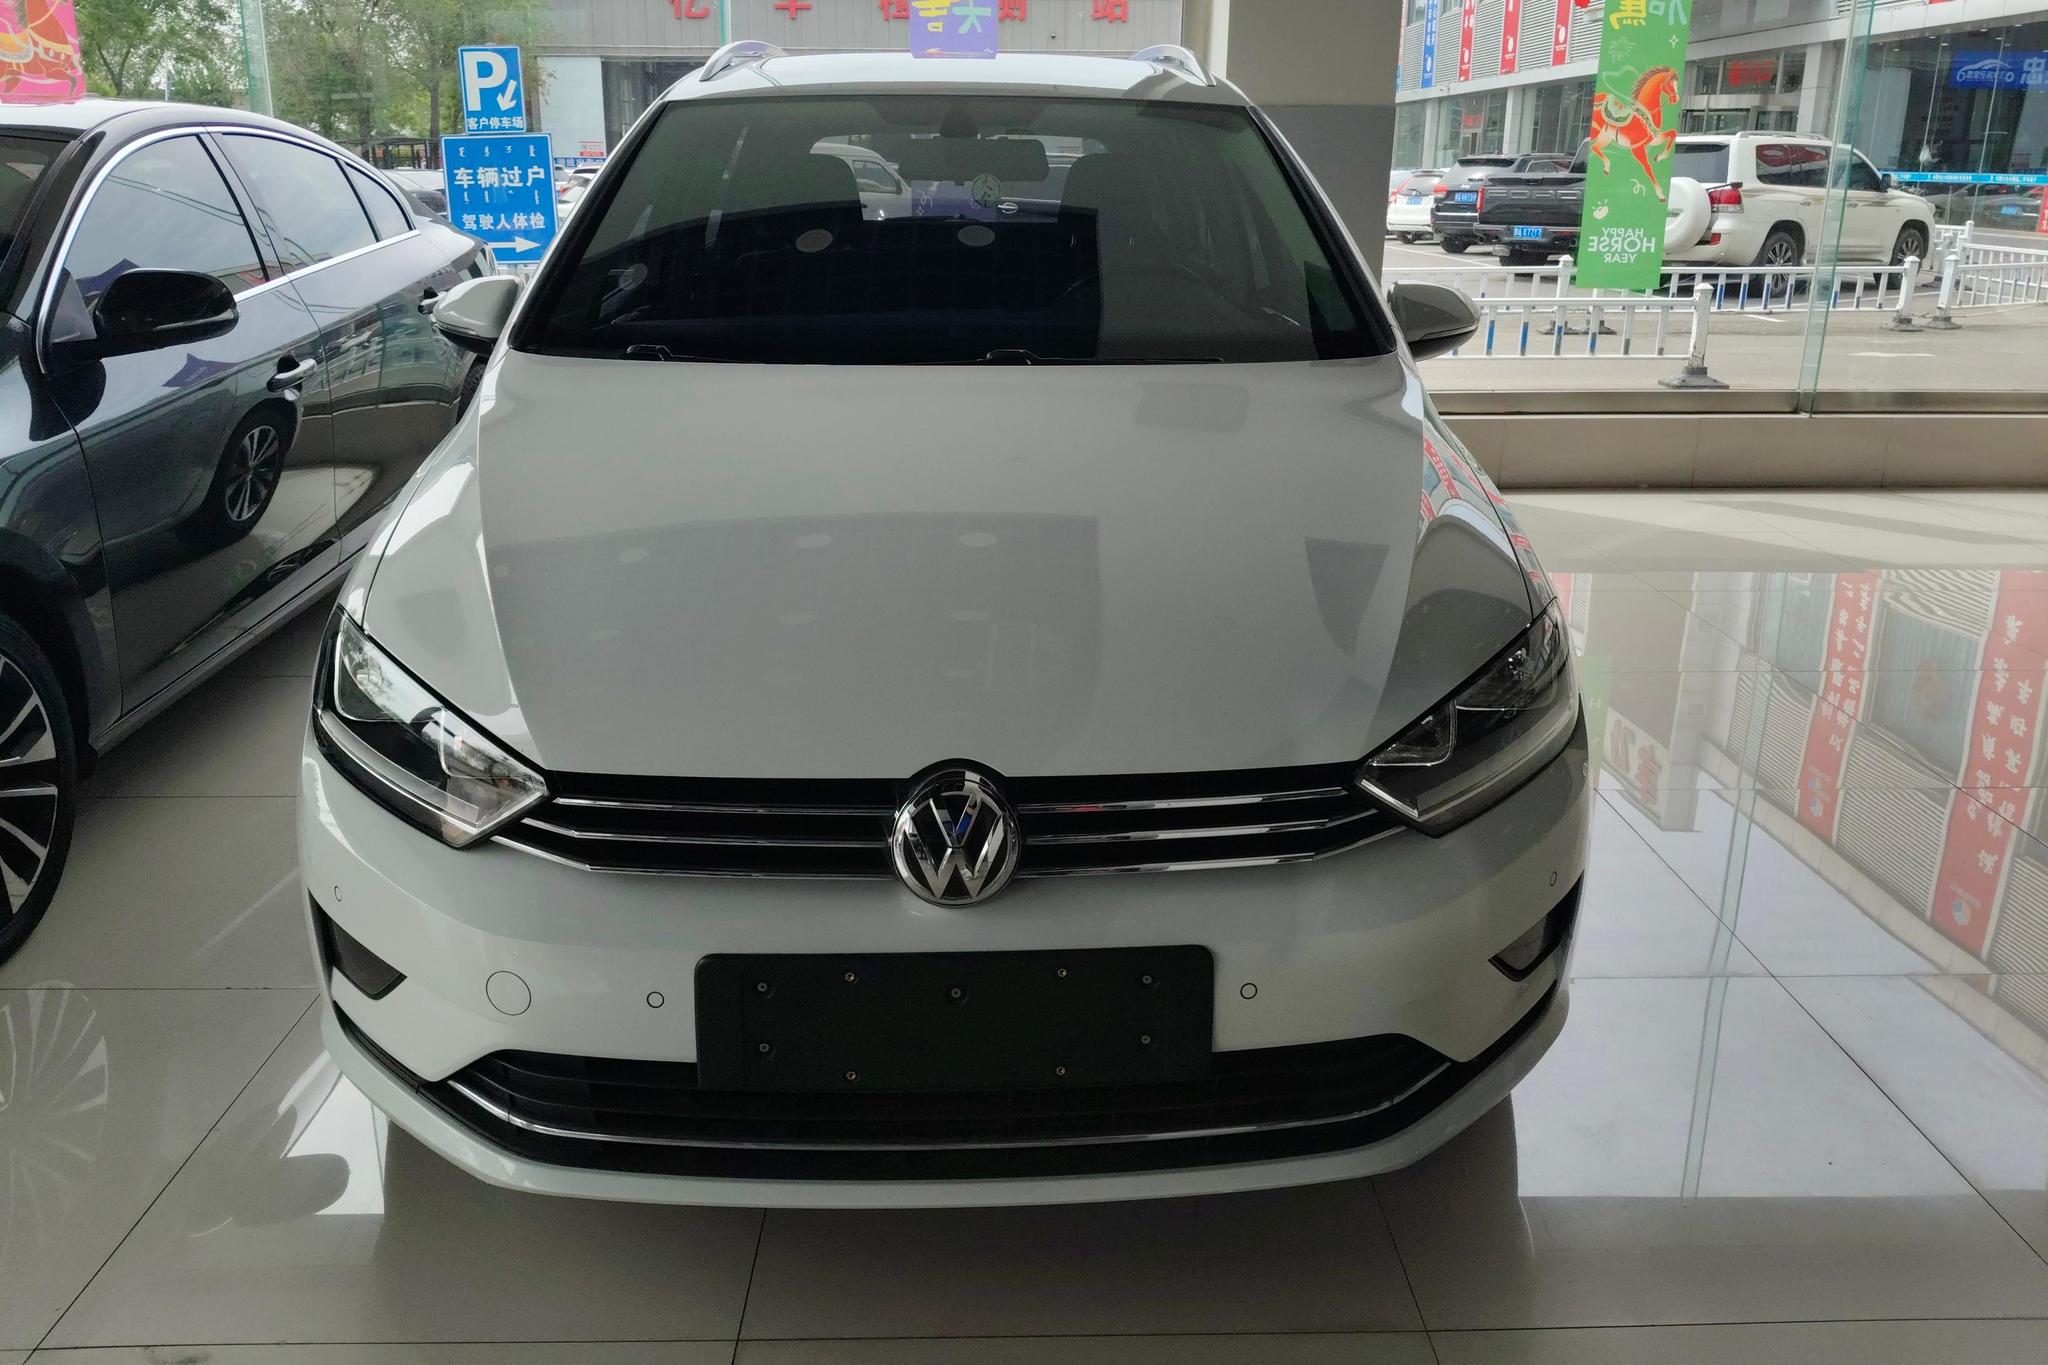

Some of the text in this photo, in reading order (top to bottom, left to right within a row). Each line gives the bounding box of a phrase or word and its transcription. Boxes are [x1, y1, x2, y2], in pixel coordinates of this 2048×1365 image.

[463, 51, 507, 112] P
[467, 116, 525, 130] 客户停车场
[453, 165, 545, 189] 车辆过户
[462, 213, 546, 231] 驾驶人体检
